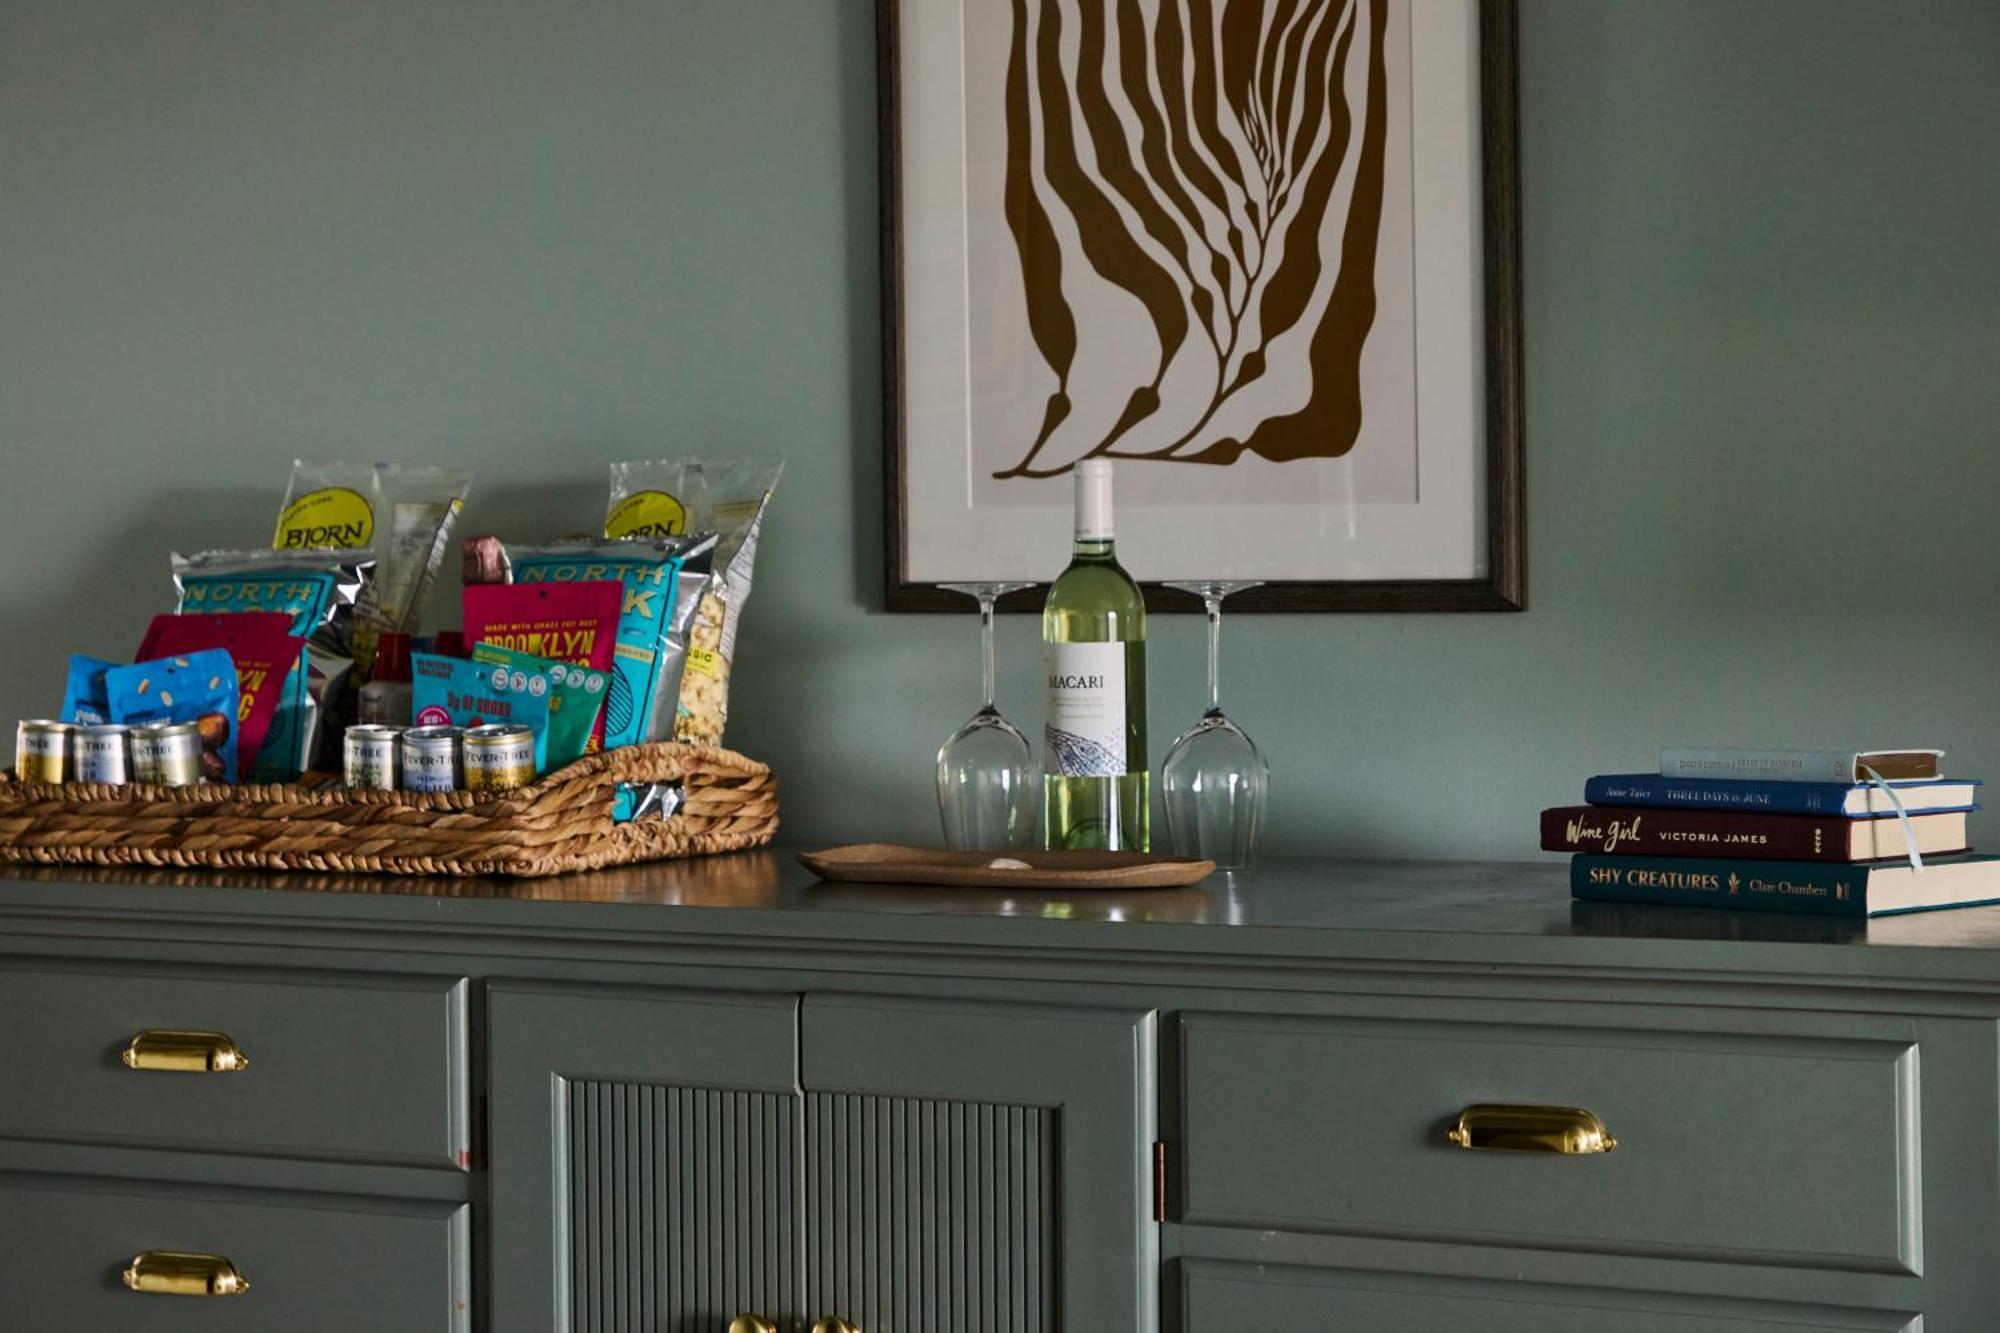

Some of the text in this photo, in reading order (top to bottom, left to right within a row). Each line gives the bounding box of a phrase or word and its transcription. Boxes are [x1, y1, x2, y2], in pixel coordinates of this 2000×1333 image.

[284, 520, 364, 548] BJORN
[624, 520, 675, 537] ORN
[523, 564, 666, 585] NORTH
[184, 581, 313, 603] NORTH
[1048, 675, 1104, 689] MACARI
[1665, 788, 1701, 801] THREE
[1703, 790, 1730, 802] DAYS
[1743, 792, 1771, 805] JUNE
[1566, 813, 1768, 852] Wine girl VICTORIA JAMES
[1589, 867, 1623, 885] SHY
[1626, 869, 1719, 891] CREATURES
